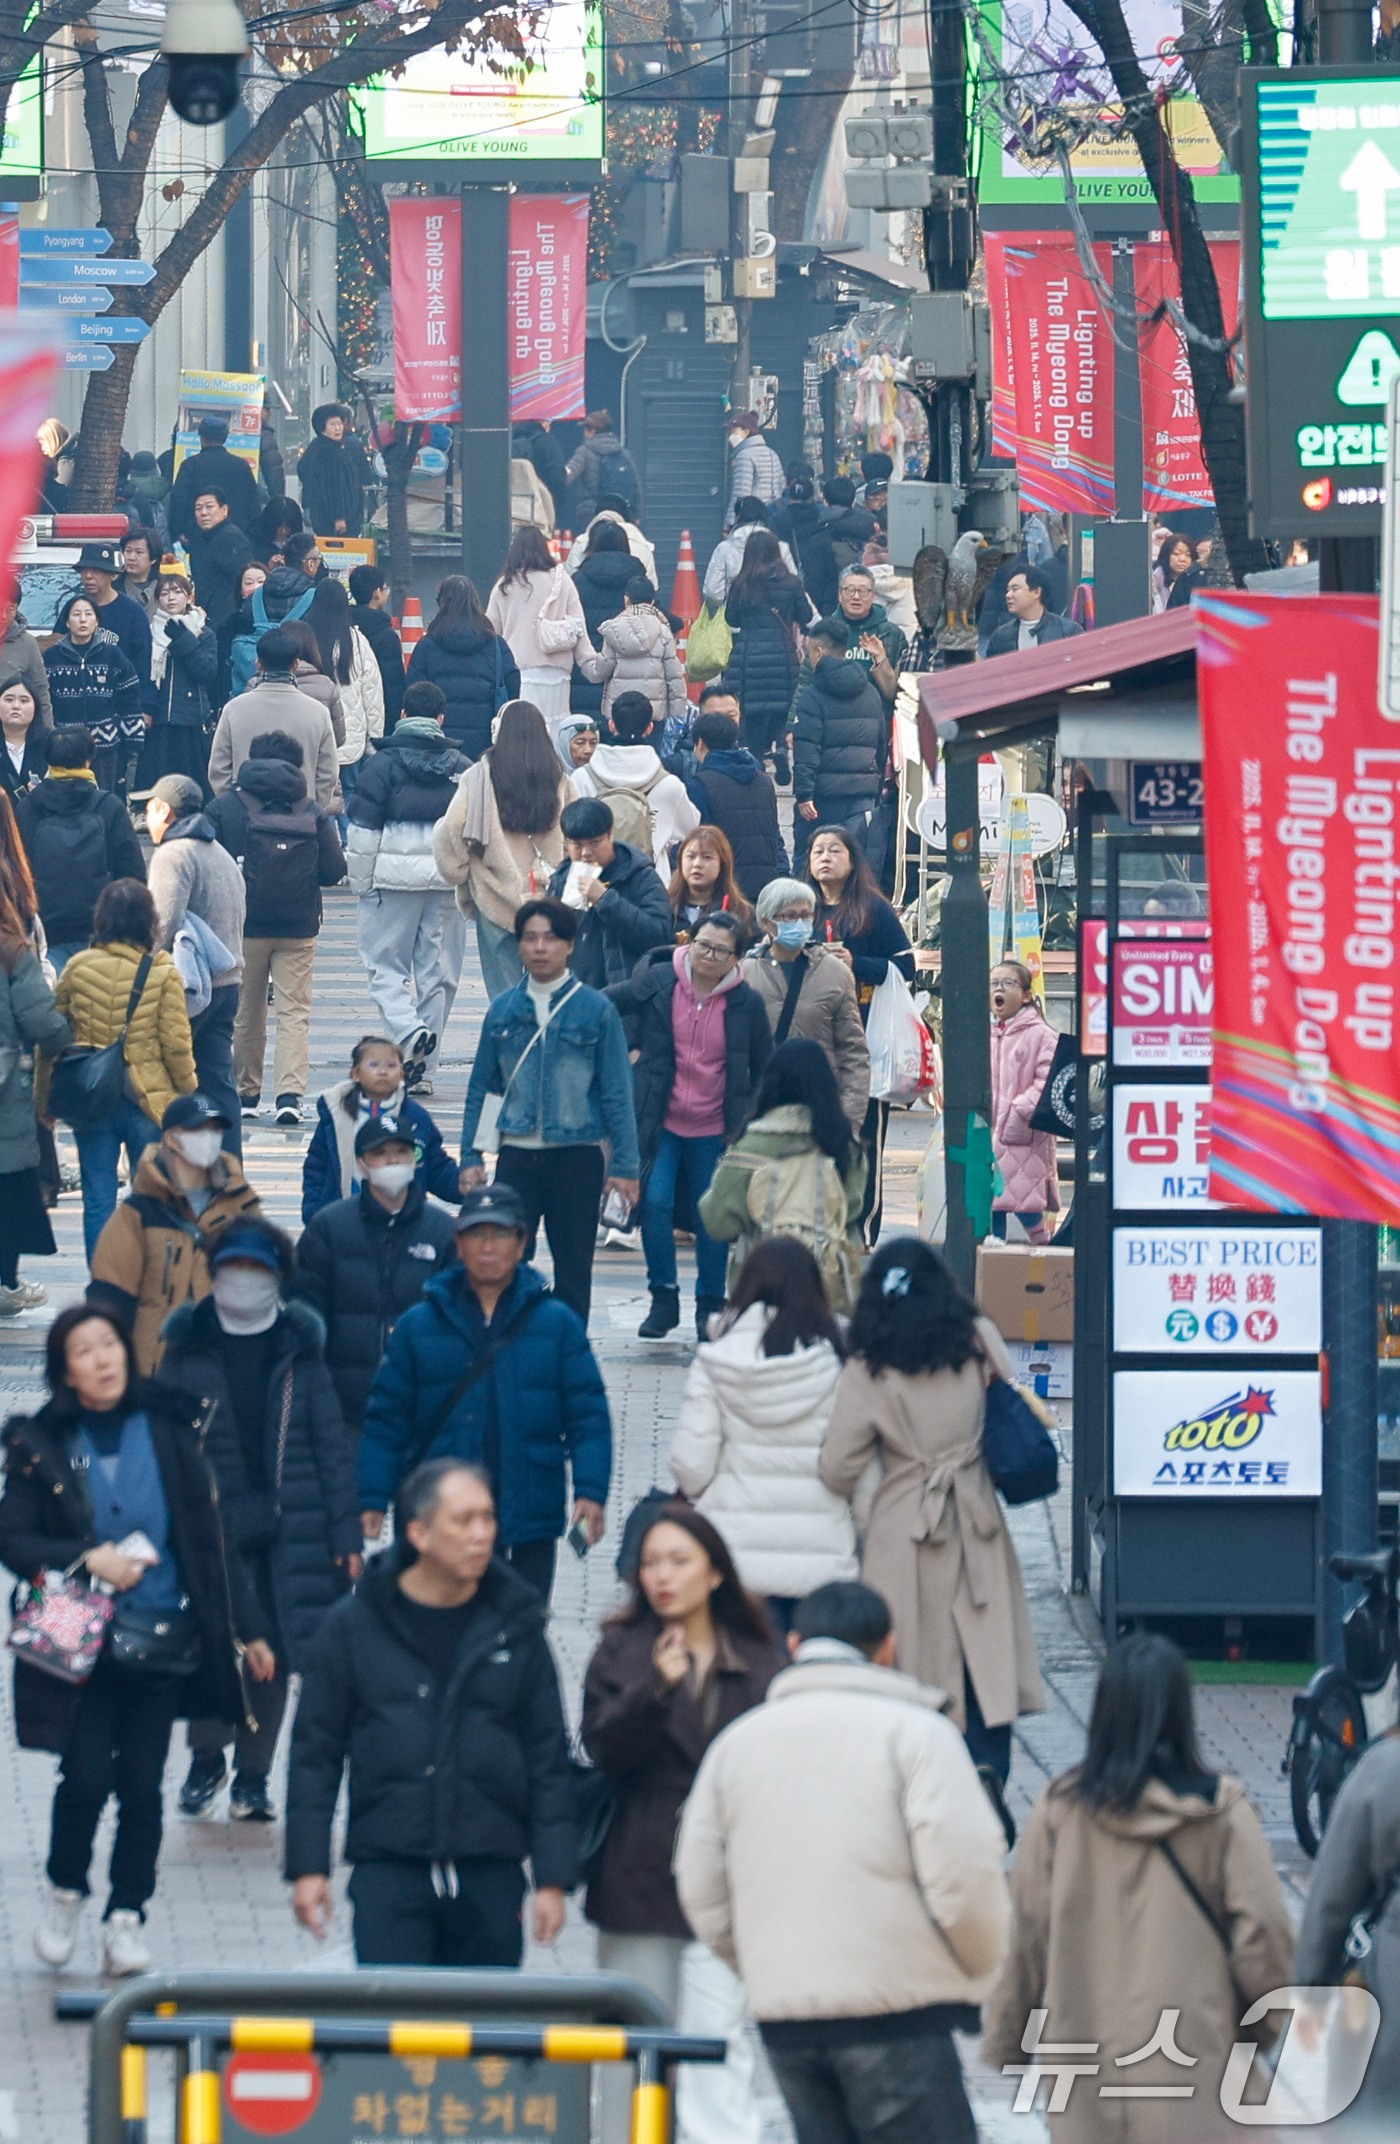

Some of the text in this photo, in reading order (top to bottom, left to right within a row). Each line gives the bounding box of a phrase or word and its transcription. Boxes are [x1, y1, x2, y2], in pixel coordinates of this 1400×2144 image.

[477, 101, 506, 109] YOUNG
[439, 141, 528, 153] OLIVE YOUNG
[44, 235, 85, 248] Pyongyang
[74, 265, 117, 276] Moscow
[58, 294, 87, 304] London
[80, 324, 114, 336] Beijing
[1028, 317, 1039, 339] 2025.
[65, 352, 87, 362] Berlin
[1045, 277, 1074, 470] The Myeong Dong
[1033, 380, 1042, 402] 2026.
[245, 416, 256, 428] 7F
[1076, 411, 1094, 439] up
[1172, 472, 1203, 482] LOTTE
[1139, 779, 1205, 807] 43-2
[1275, 671, 1340, 1113] The Myeong Dong
[1121, 964, 1214, 1017] SIM
[1343, 981, 1395, 1051] up
[1126, 1240, 1317, 1267] BEST PRICE
[1165, 1410, 1263, 1452] toto
[1152, 1461, 1290, 1487] 스포츠토토
[352, 2090, 558, 2136] 차없는거리
